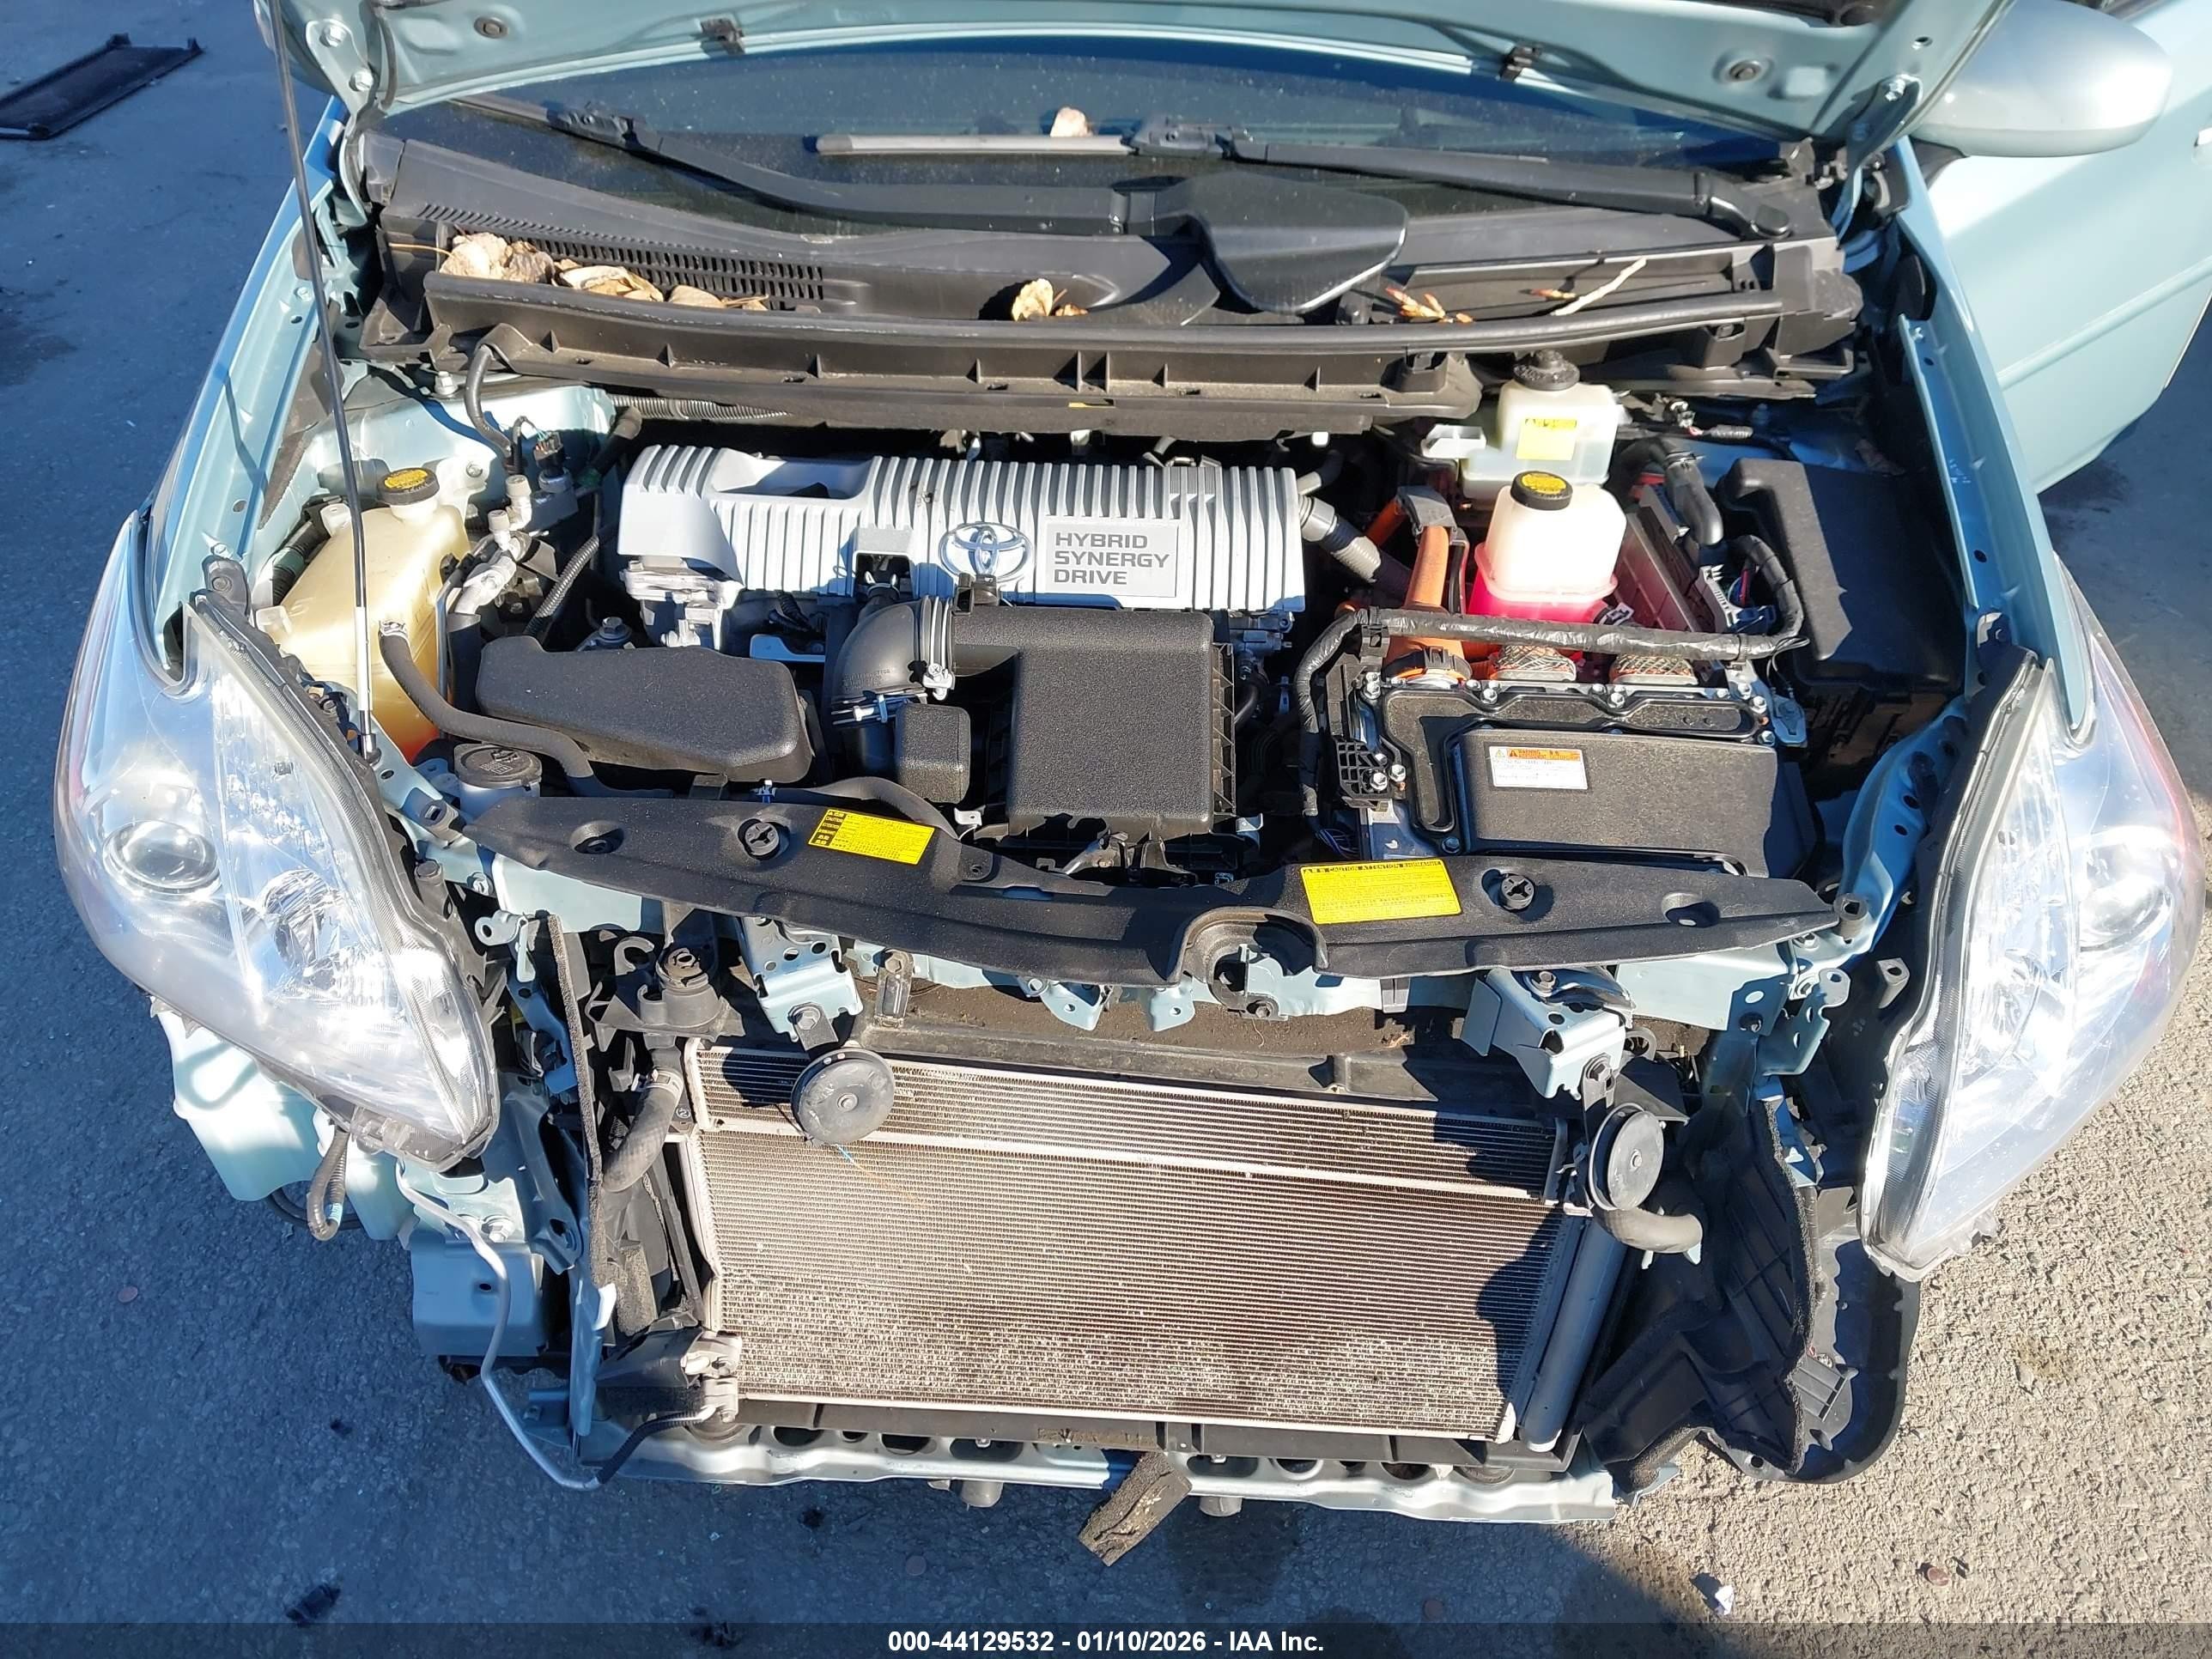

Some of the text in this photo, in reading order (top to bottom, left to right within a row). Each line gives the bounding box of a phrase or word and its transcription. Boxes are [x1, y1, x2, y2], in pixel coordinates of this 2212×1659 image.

[1056, 532, 1148, 549] HYBRID
[1054, 551, 1170, 568] SYNERGY
[1054, 569, 1127, 585] DRIVE
